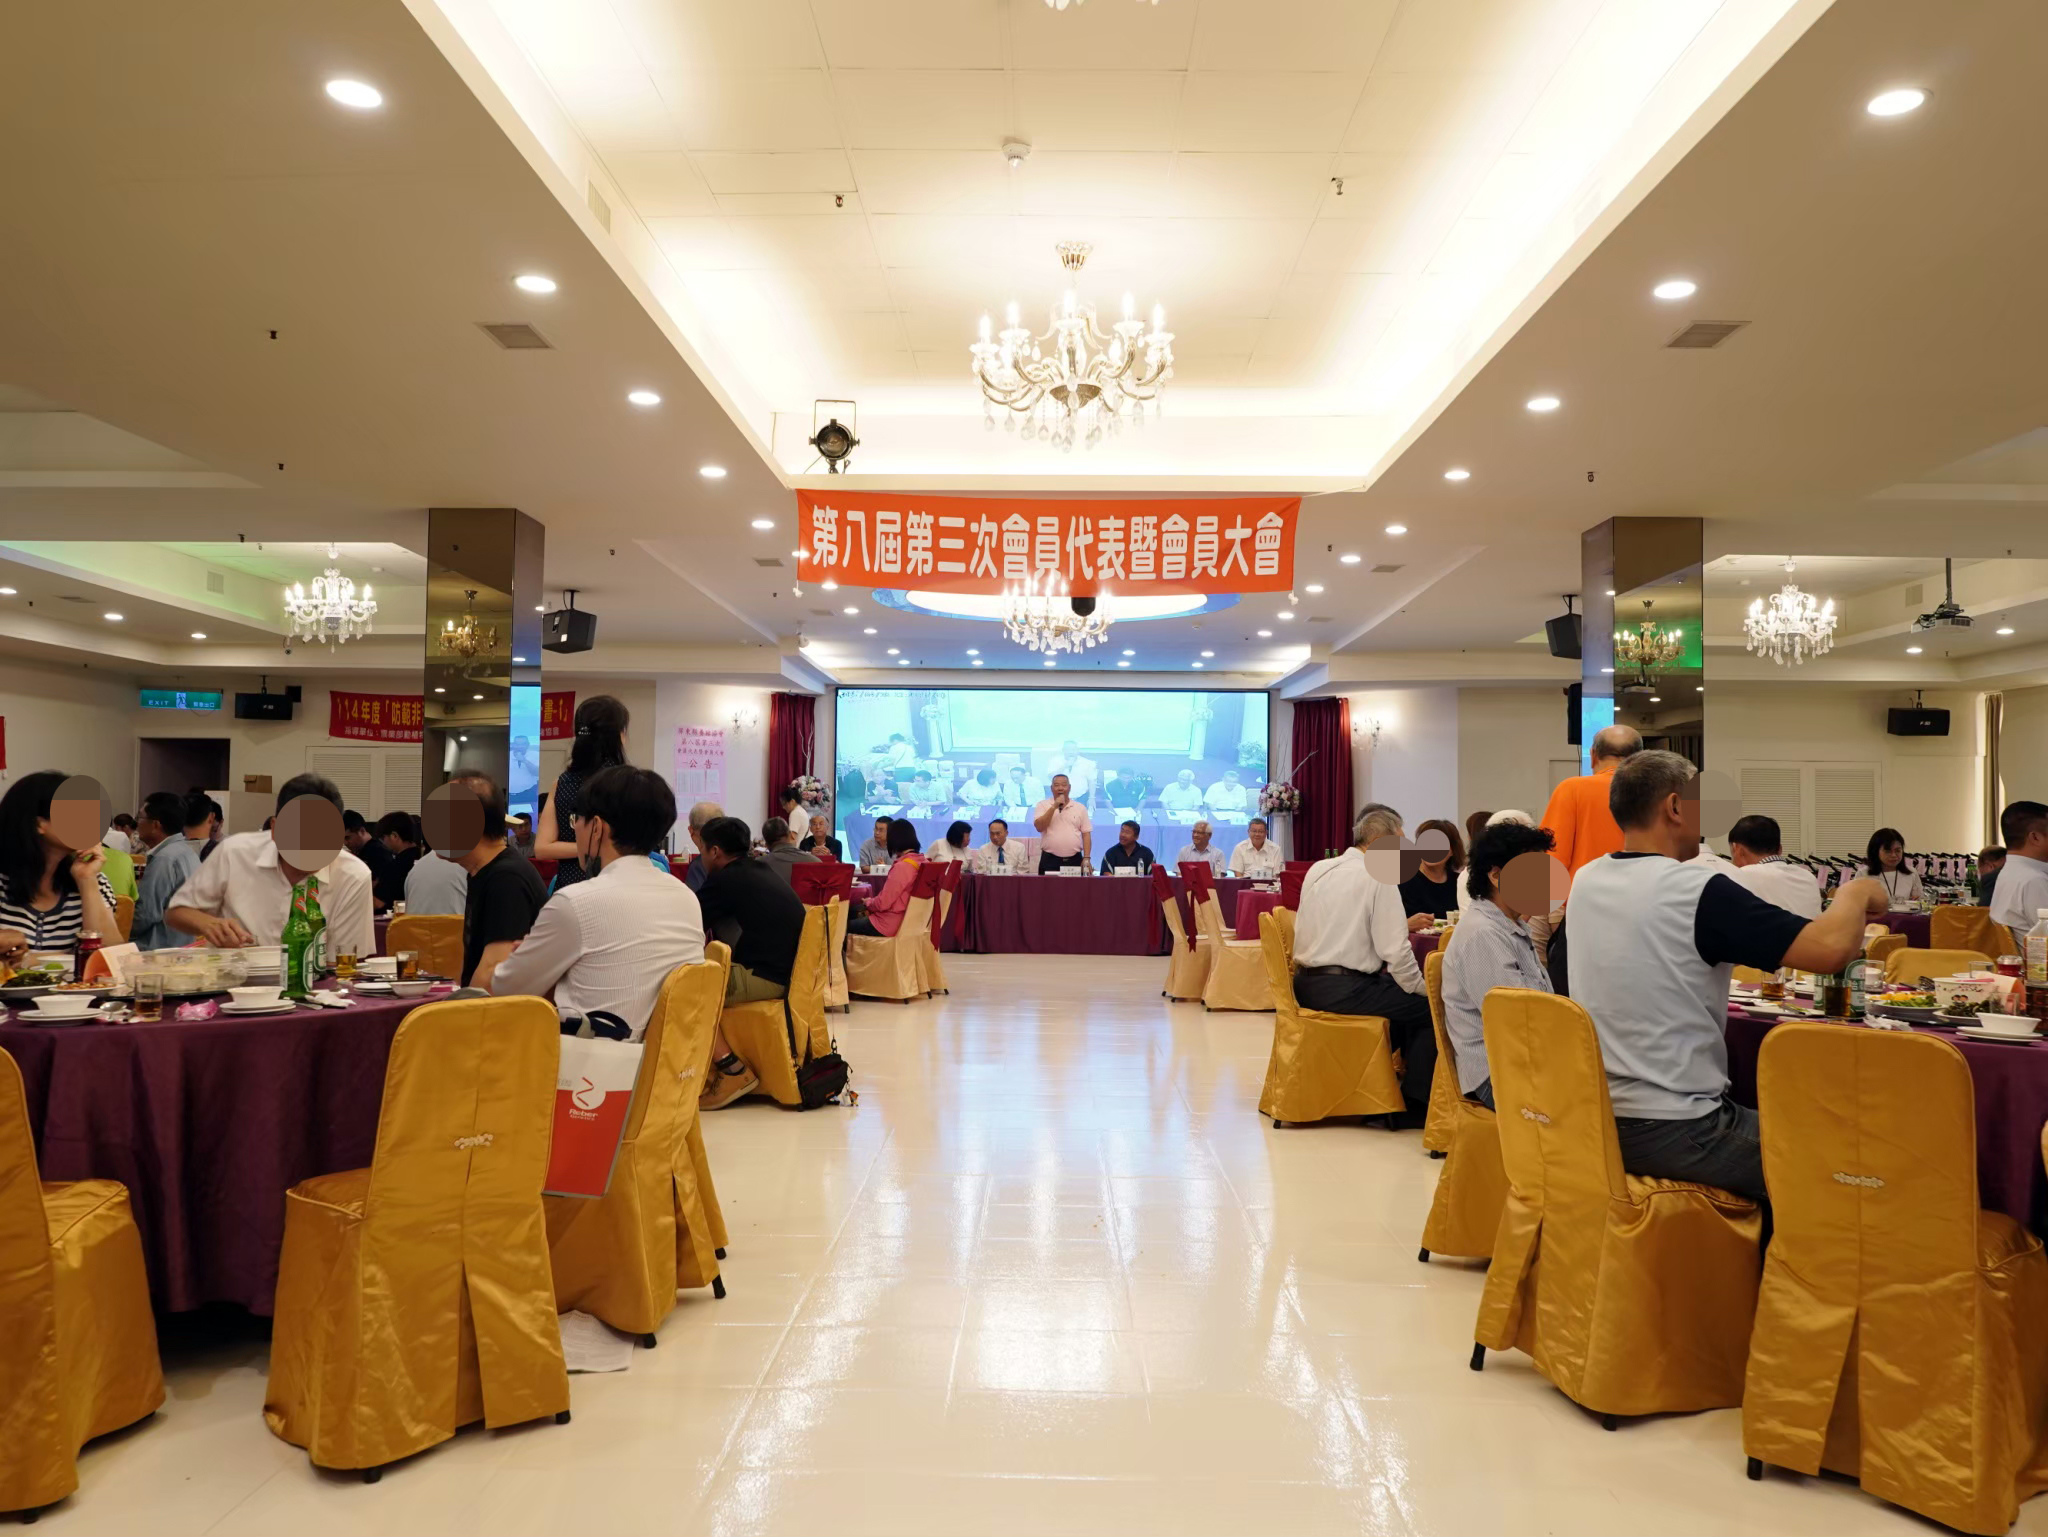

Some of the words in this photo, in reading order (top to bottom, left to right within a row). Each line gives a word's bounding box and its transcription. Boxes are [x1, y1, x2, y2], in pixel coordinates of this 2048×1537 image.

[811, 504, 1284, 581] 第八屆第三次會員代表暨會員大會
[337, 698, 424, 726] 114年度「防範非
